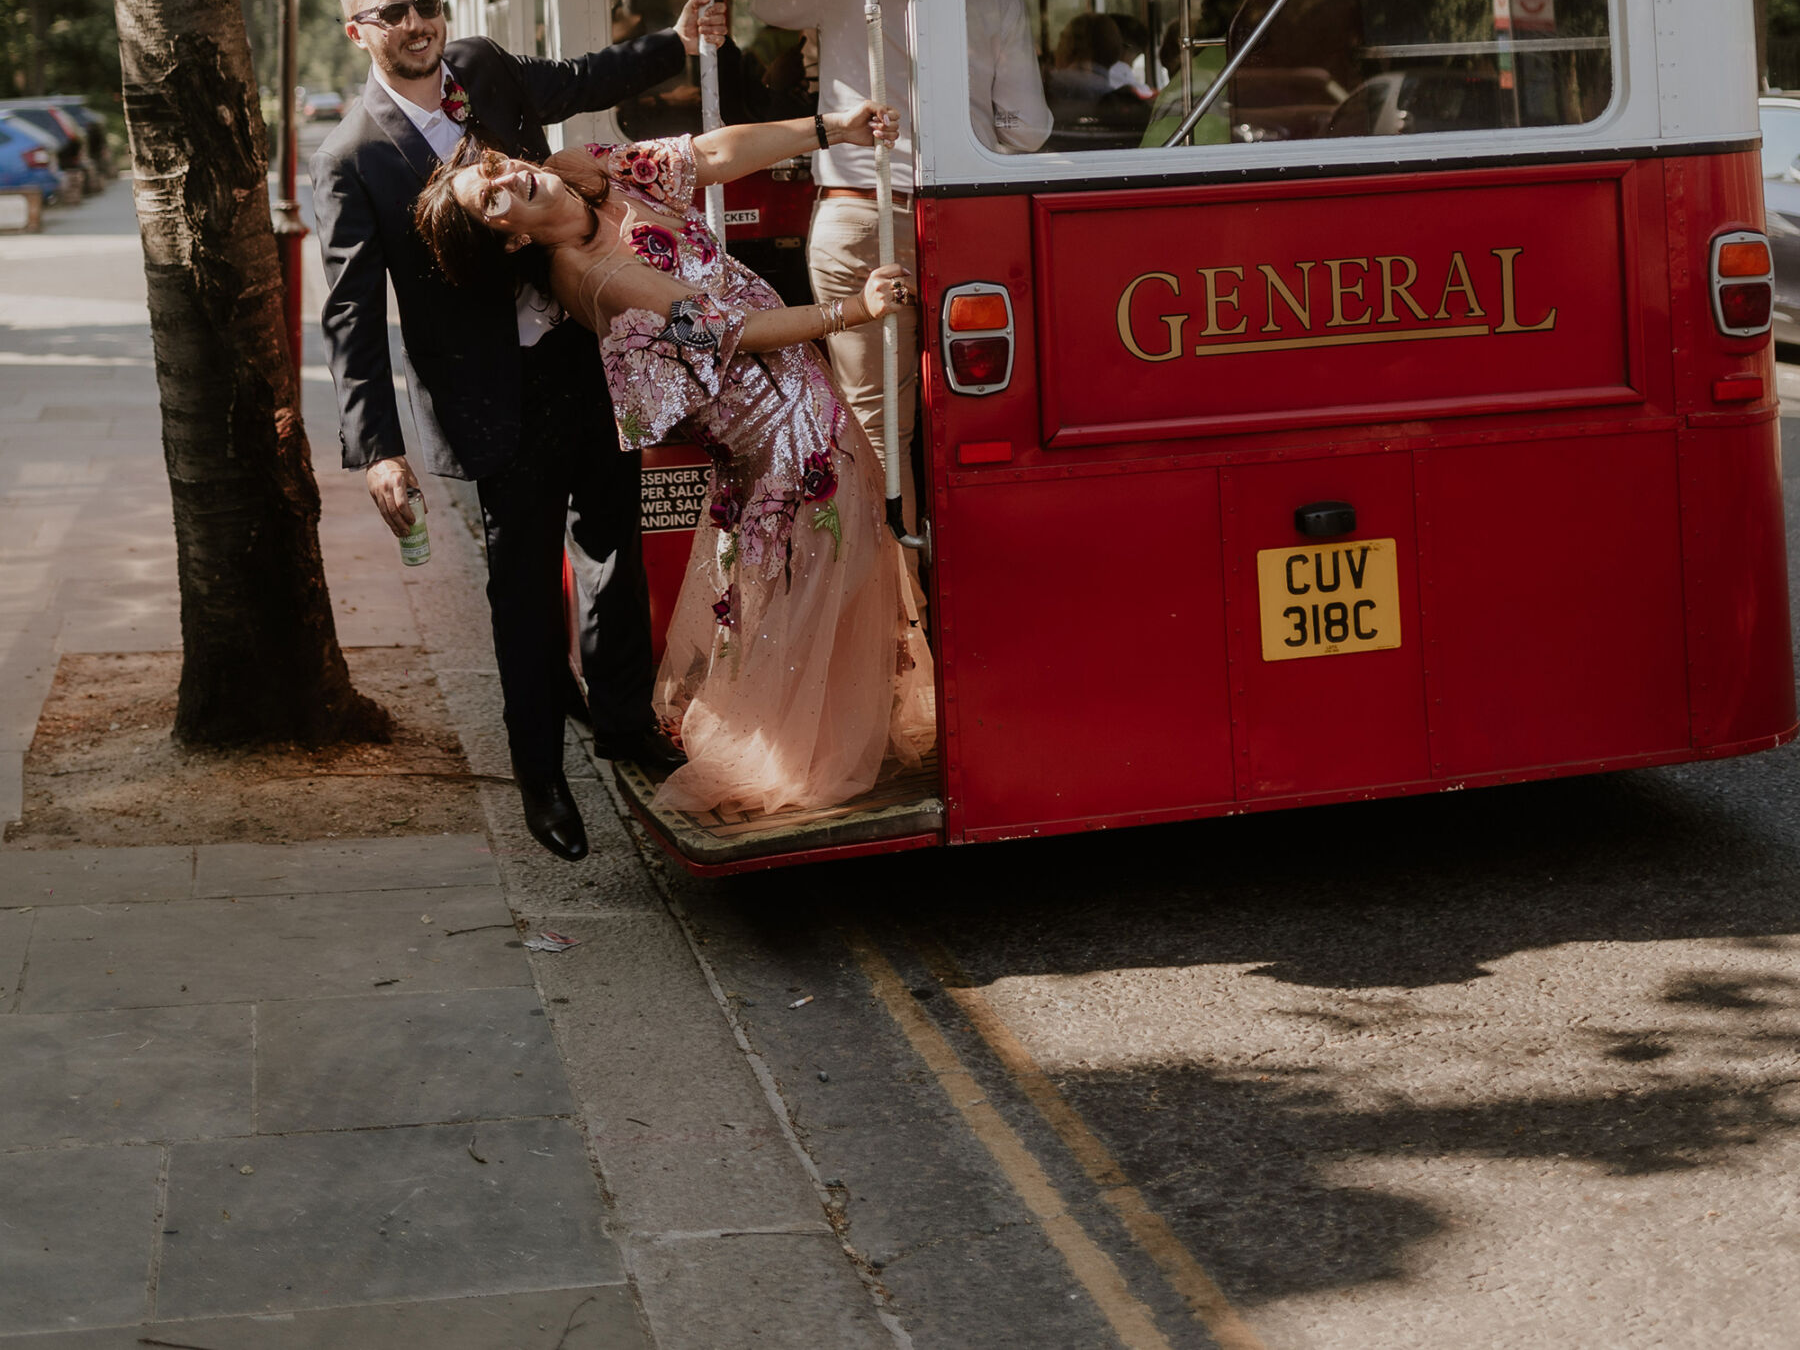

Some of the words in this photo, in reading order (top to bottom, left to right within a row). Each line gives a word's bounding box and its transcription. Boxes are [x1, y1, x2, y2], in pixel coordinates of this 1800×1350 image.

[1115, 247, 1558, 363] GENERAL
[669, 484, 708, 498] SALO
[676, 499, 703, 511] SAL
[1285, 548, 1369, 595] CUV
[1282, 599, 1378, 647] 318C
